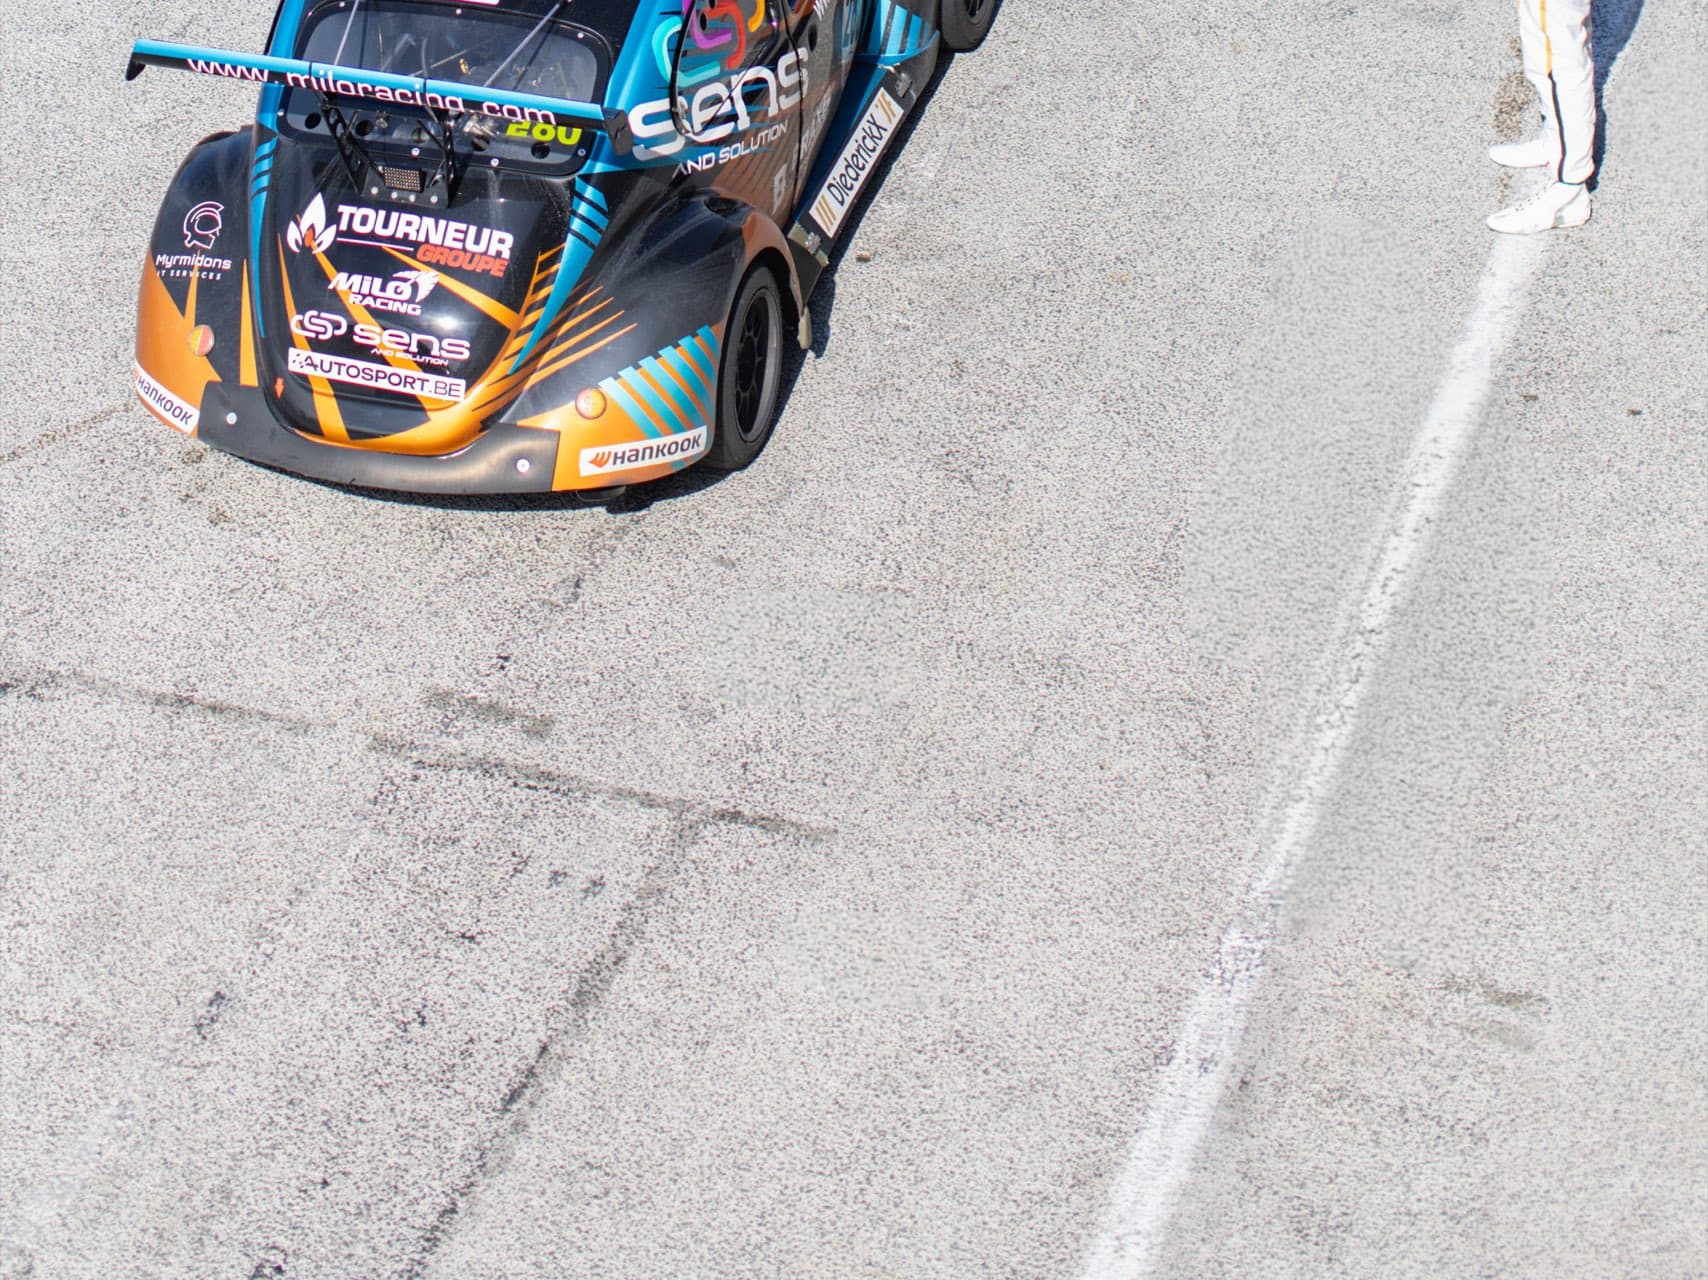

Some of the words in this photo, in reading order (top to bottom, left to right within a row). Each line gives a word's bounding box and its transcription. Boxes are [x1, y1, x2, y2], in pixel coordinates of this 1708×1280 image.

[718, 120, 788, 165] SOLUTION
[337, 204, 514, 260] TOURNEUR
[155, 253, 233, 270] Myrmidons
[416, 244, 510, 278] GROUPE
[348, 293, 422, 316] RACING
[395, 351, 449, 367] SOLUTION
[304, 355, 462, 398] AUTOSPORT.BE
